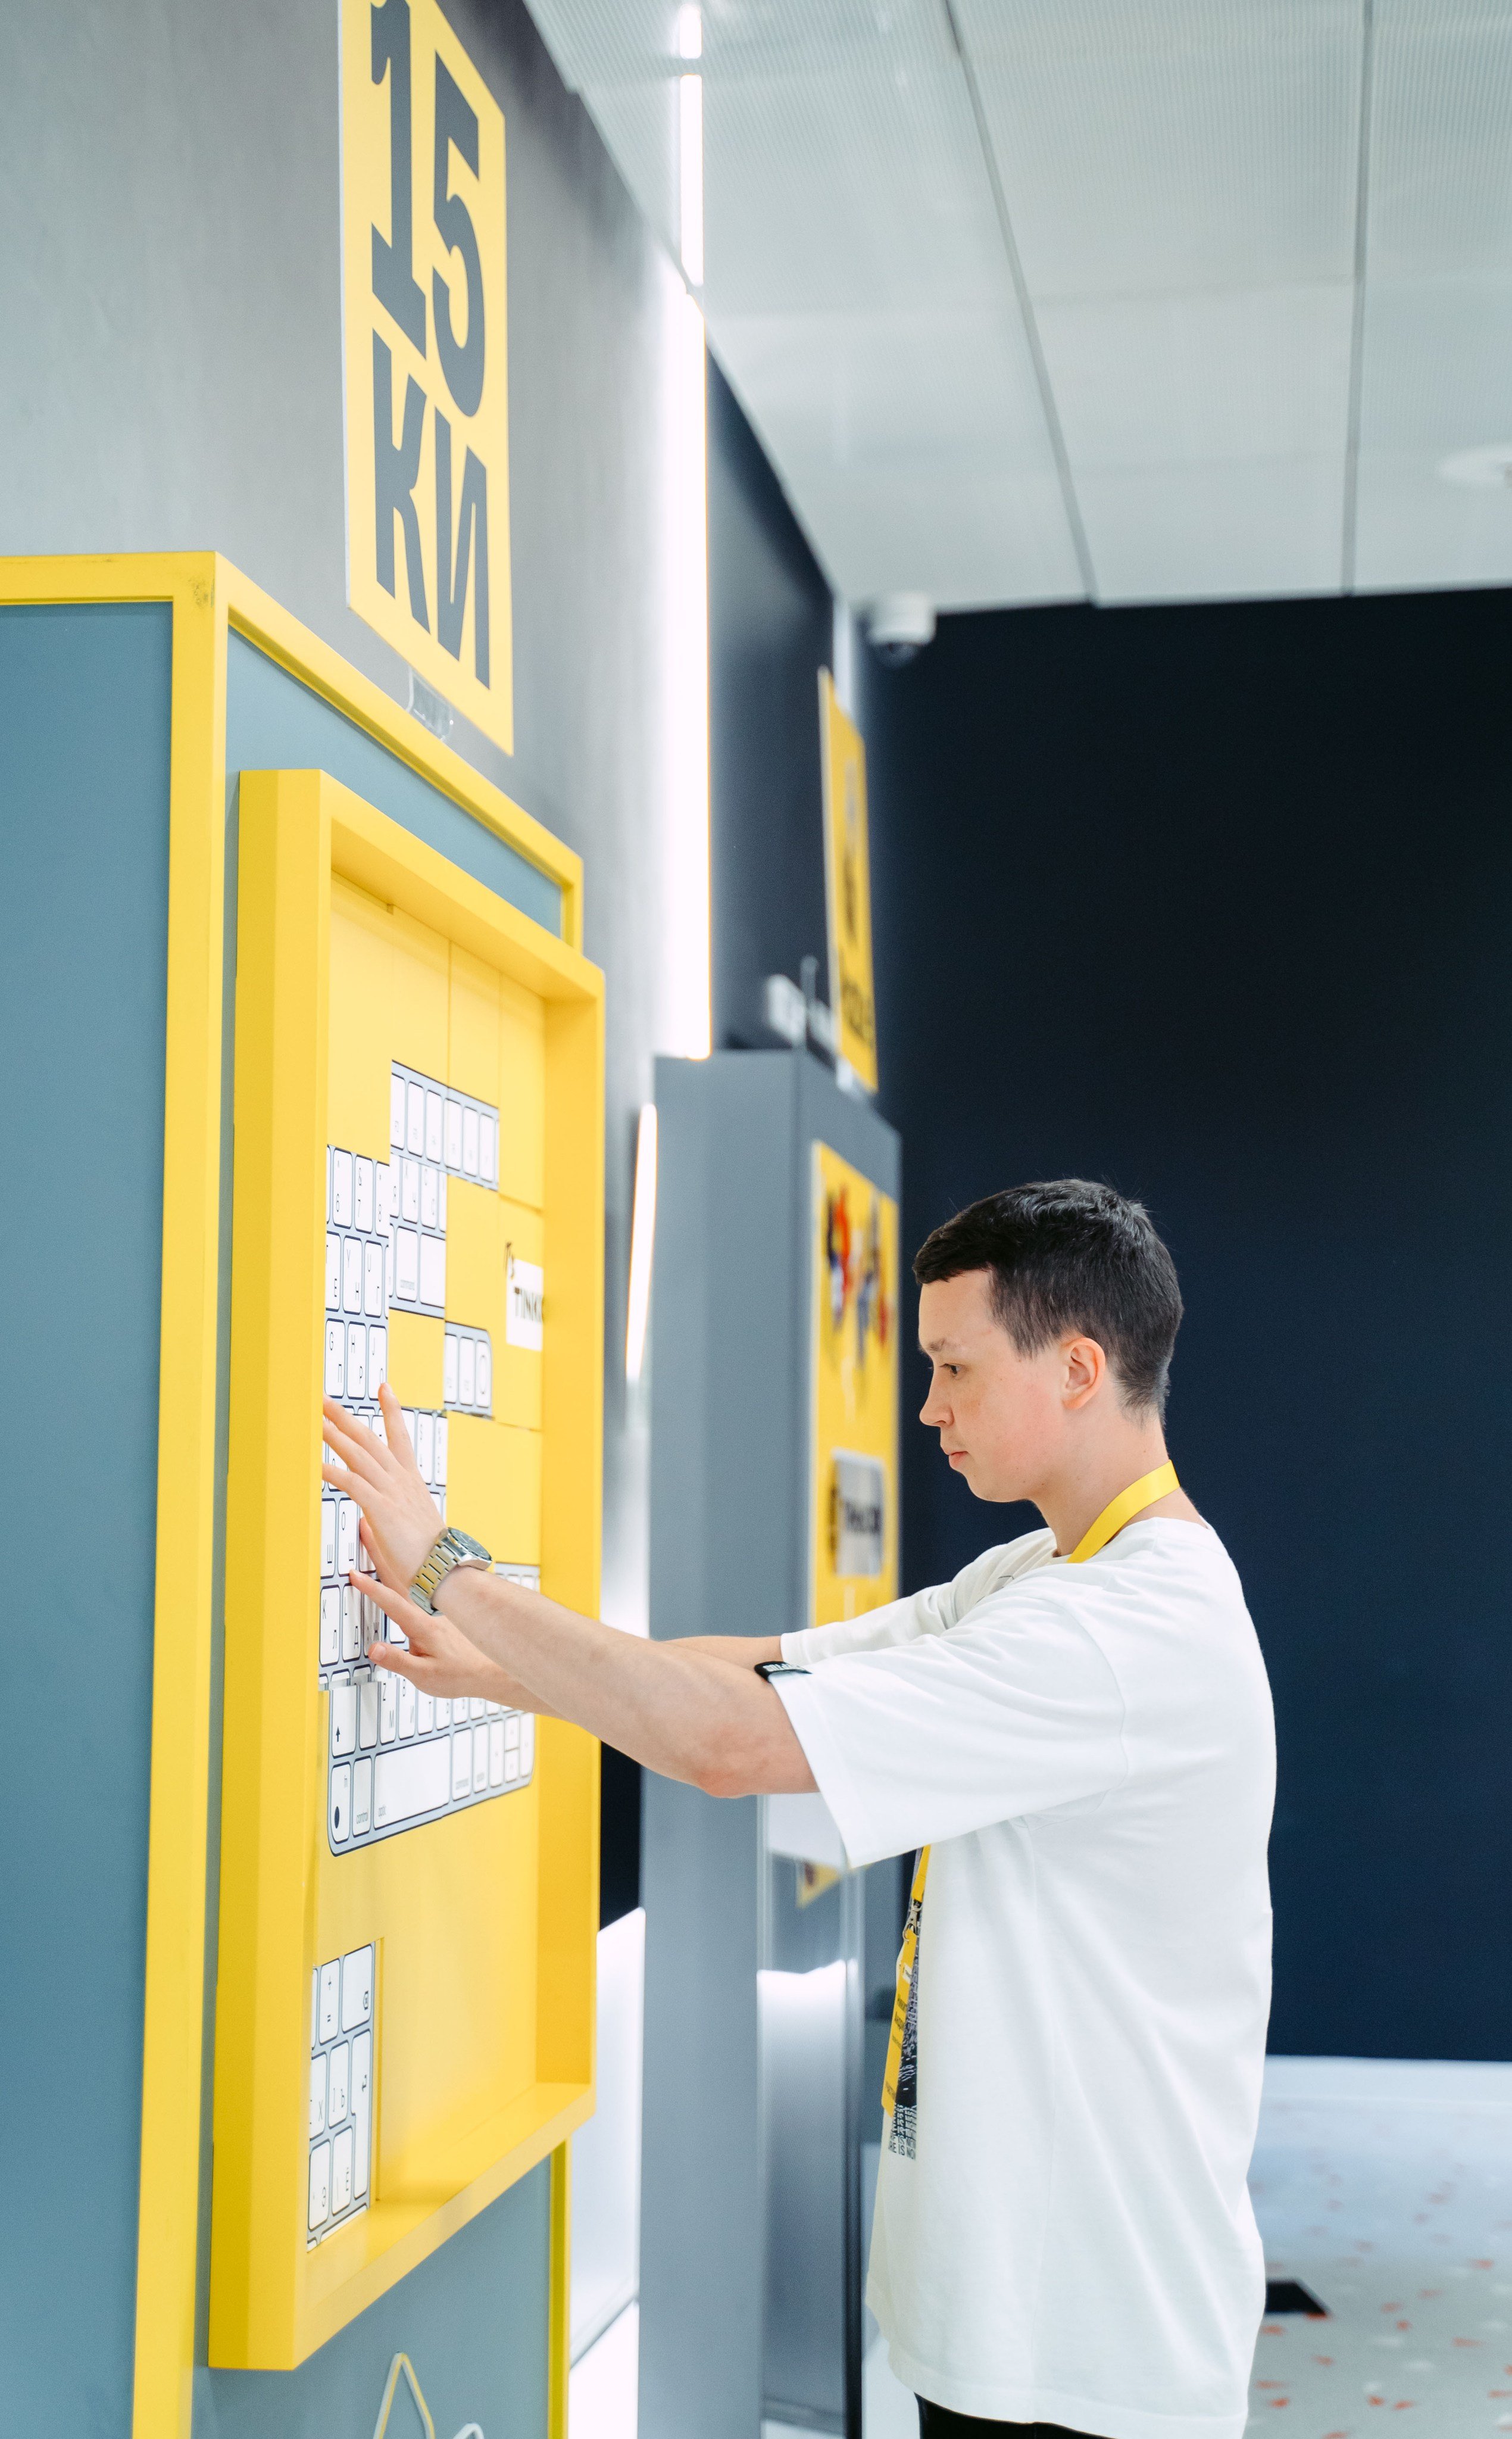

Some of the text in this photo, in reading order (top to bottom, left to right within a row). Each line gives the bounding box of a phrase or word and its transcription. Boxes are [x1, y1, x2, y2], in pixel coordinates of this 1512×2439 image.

[370, 0, 486, 417] 15
[372, 327, 491, 690] КИ
[336, 1193, 340, 1212] 6
[357, 1199, 361, 1218] 7
[329, 1331, 334, 1351] G
[351, 1334, 356, 1353] H
[322, 1599, 327, 1620] K
